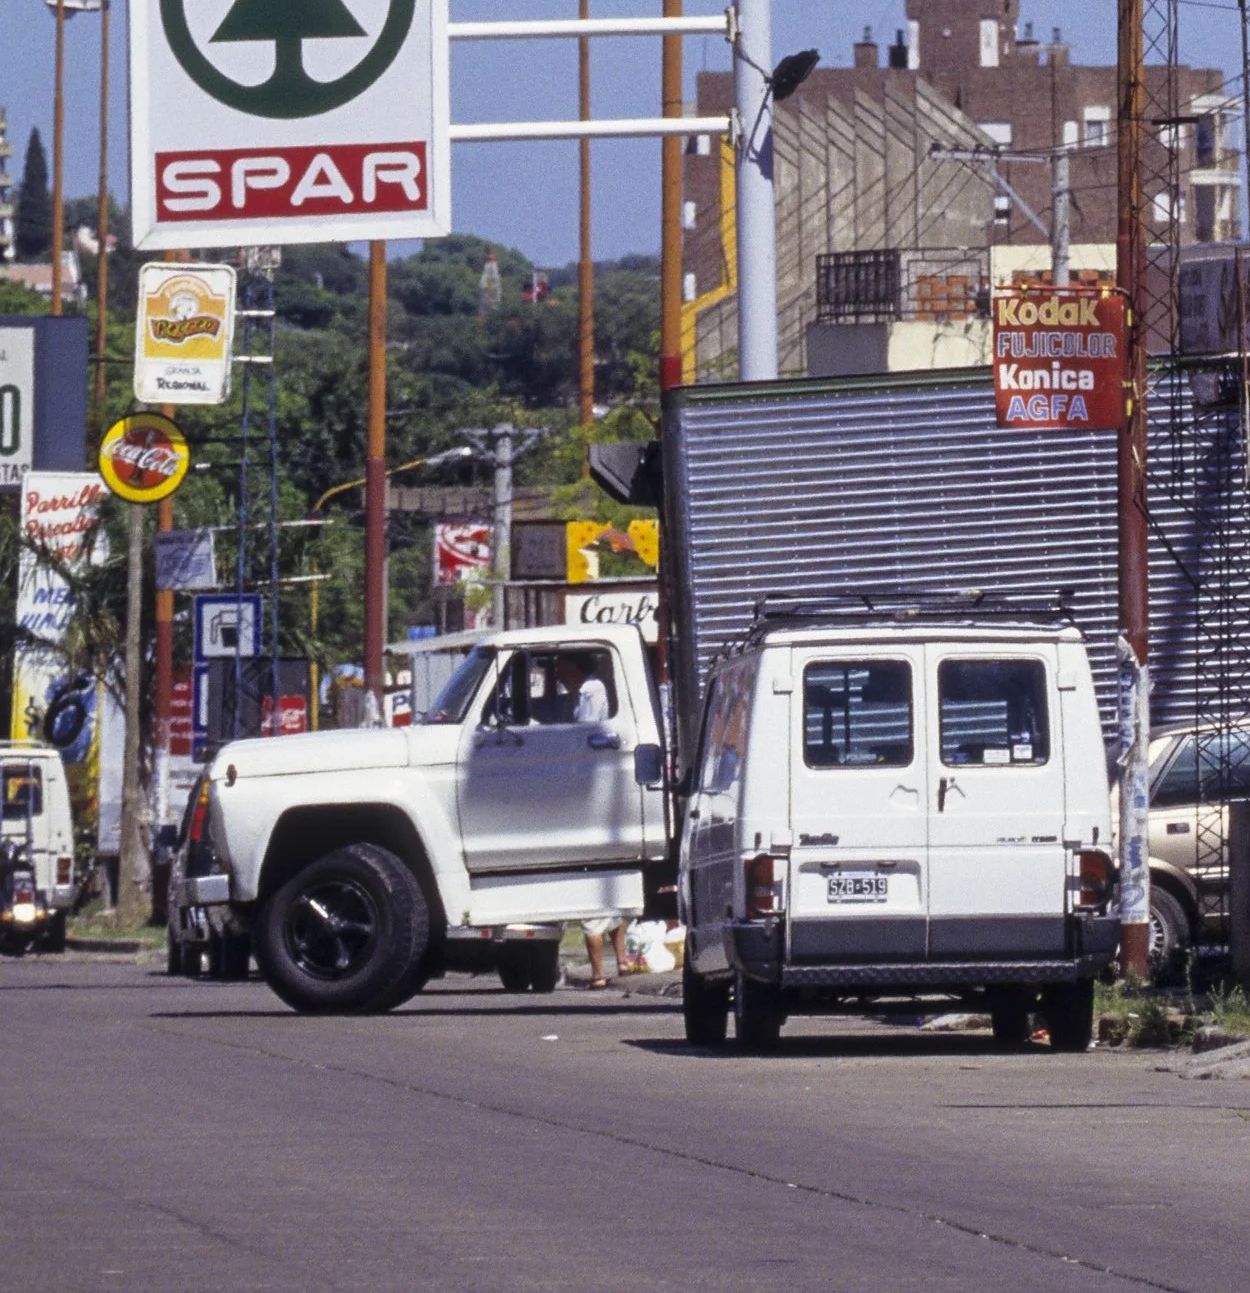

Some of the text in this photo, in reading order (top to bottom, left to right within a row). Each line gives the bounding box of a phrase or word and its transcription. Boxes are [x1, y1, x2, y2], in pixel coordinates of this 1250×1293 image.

[162, 151, 421, 212] SPAR
[998, 296, 1100, 326] Kodak
[997, 332, 1117, 358] FUJICOLOR
[1000, 361, 1095, 390] Konica
[1006, 394, 1089, 421] AGFA
[862, 879, 886, 894] 519
